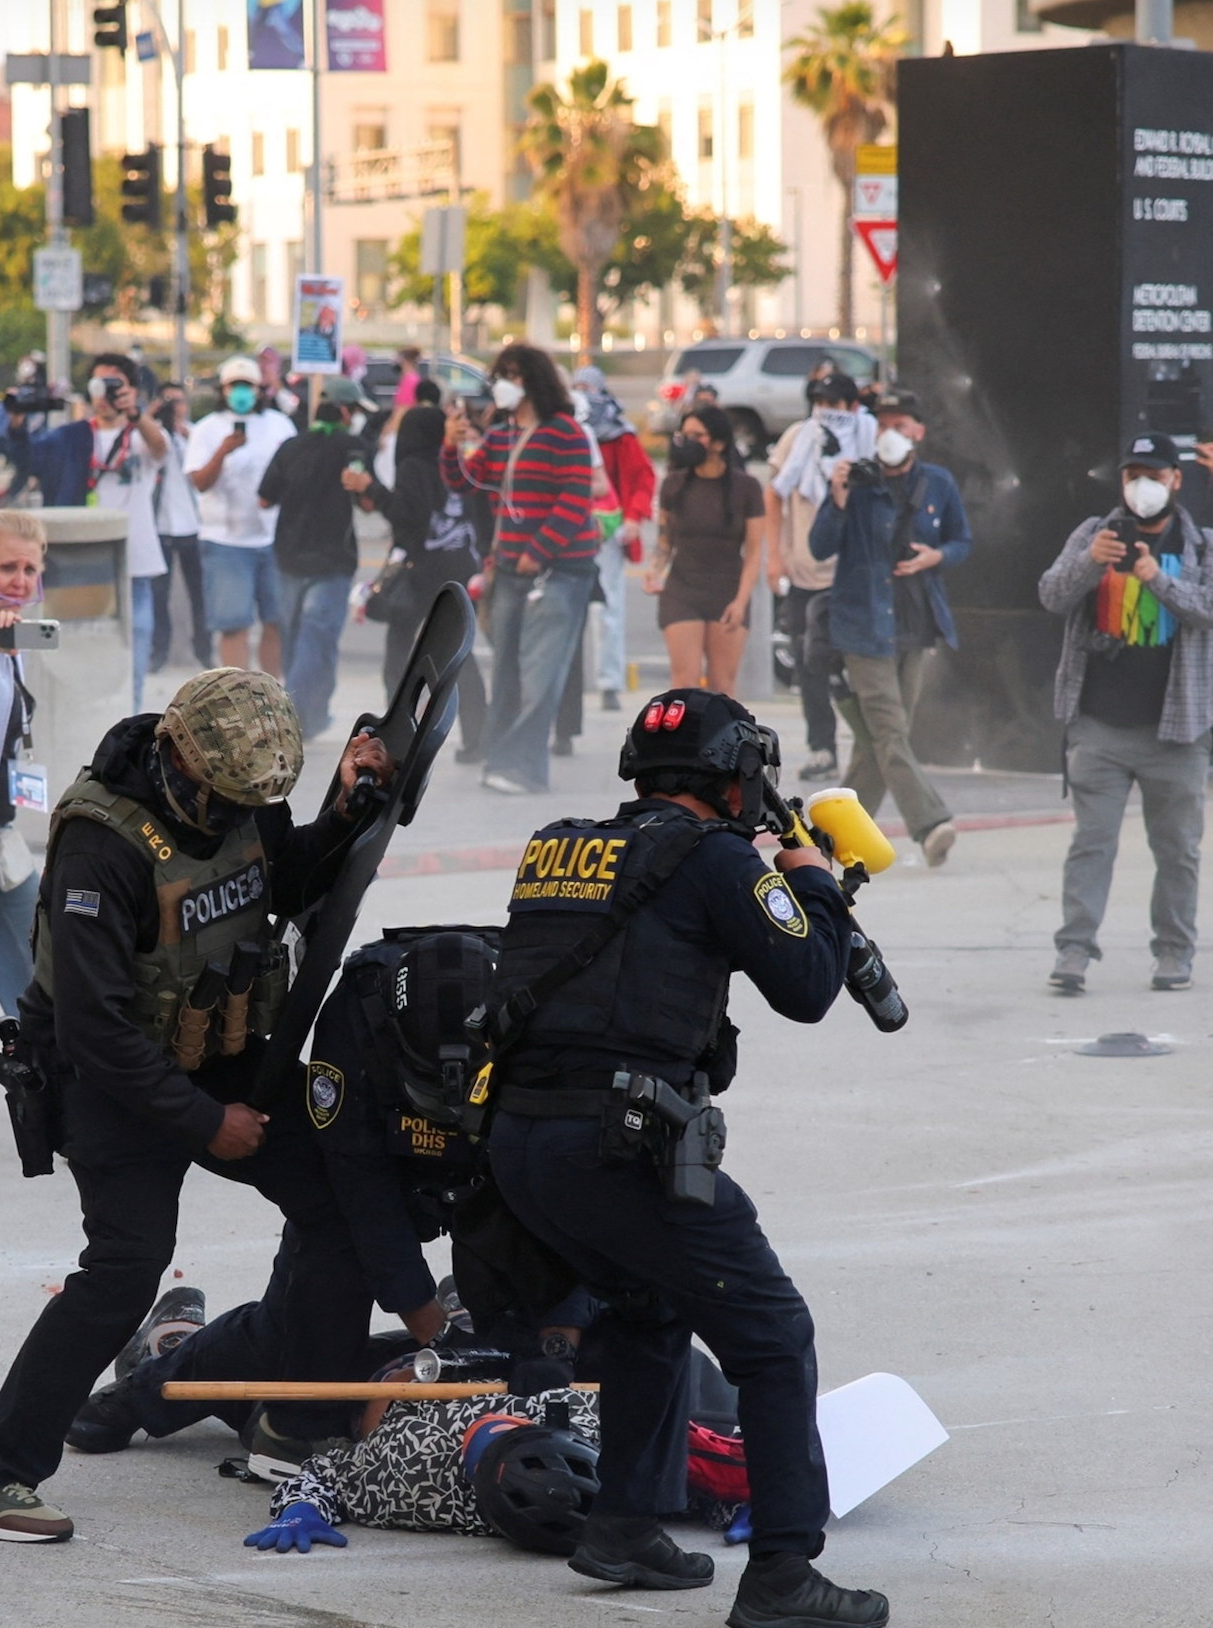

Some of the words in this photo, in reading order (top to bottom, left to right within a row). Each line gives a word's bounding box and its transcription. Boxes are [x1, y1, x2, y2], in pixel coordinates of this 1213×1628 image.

[141, 822, 172, 860] ERO
[518, 837, 627, 880] POLICE
[558, 881, 612, 901] SECURITY
[758, 877, 783, 899] POLICE
[182, 873, 251, 931] POLICE
[400, 1116, 458, 1136] POL
[627, 1114, 641, 1125] TQ
[411, 1133, 446, 1149] DHS
